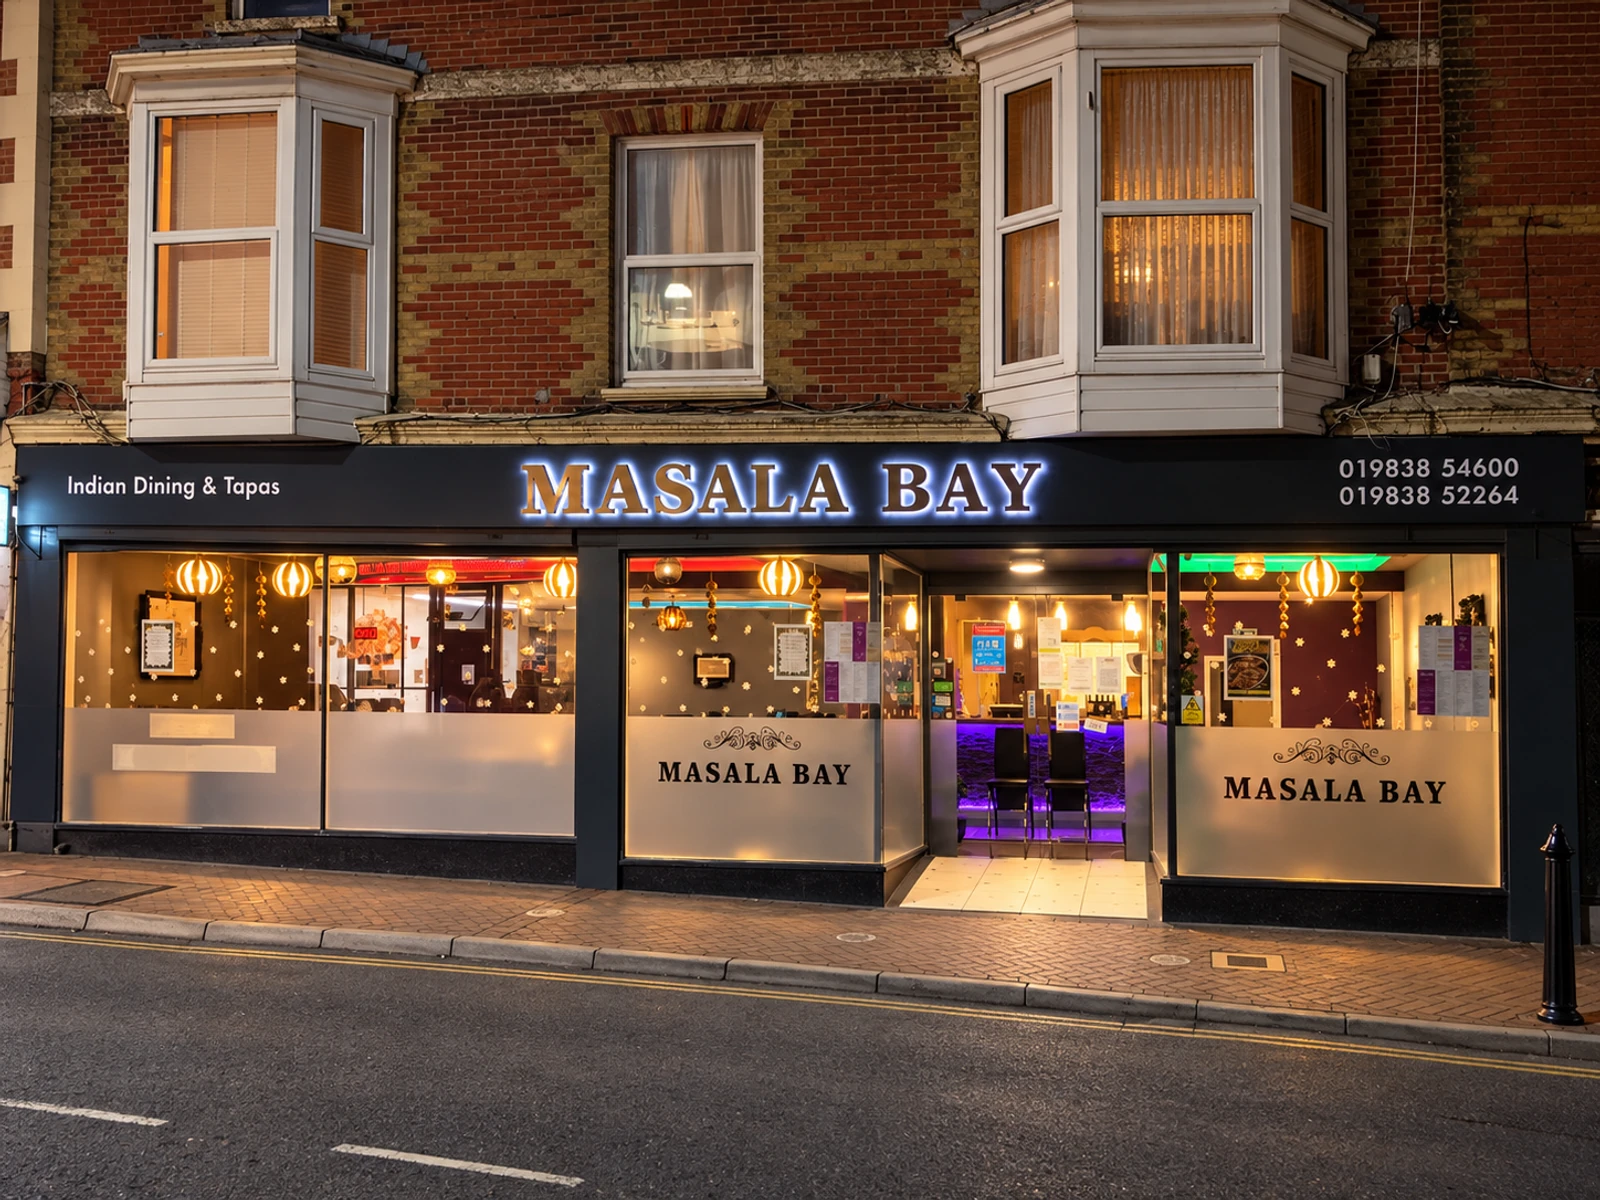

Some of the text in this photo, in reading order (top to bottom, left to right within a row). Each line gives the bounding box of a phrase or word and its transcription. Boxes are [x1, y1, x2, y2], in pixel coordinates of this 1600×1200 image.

[1339, 457, 1520, 479] 019838 54600
[67, 475, 280, 501] Indian Dining & Tapas
[519, 461, 1043, 517] MASALA BAY
[1339, 485, 1520, 506] 019838 52264
[657, 760, 852, 786] MASALA BAY
[1223, 775, 1448, 805] MASALA BAY
